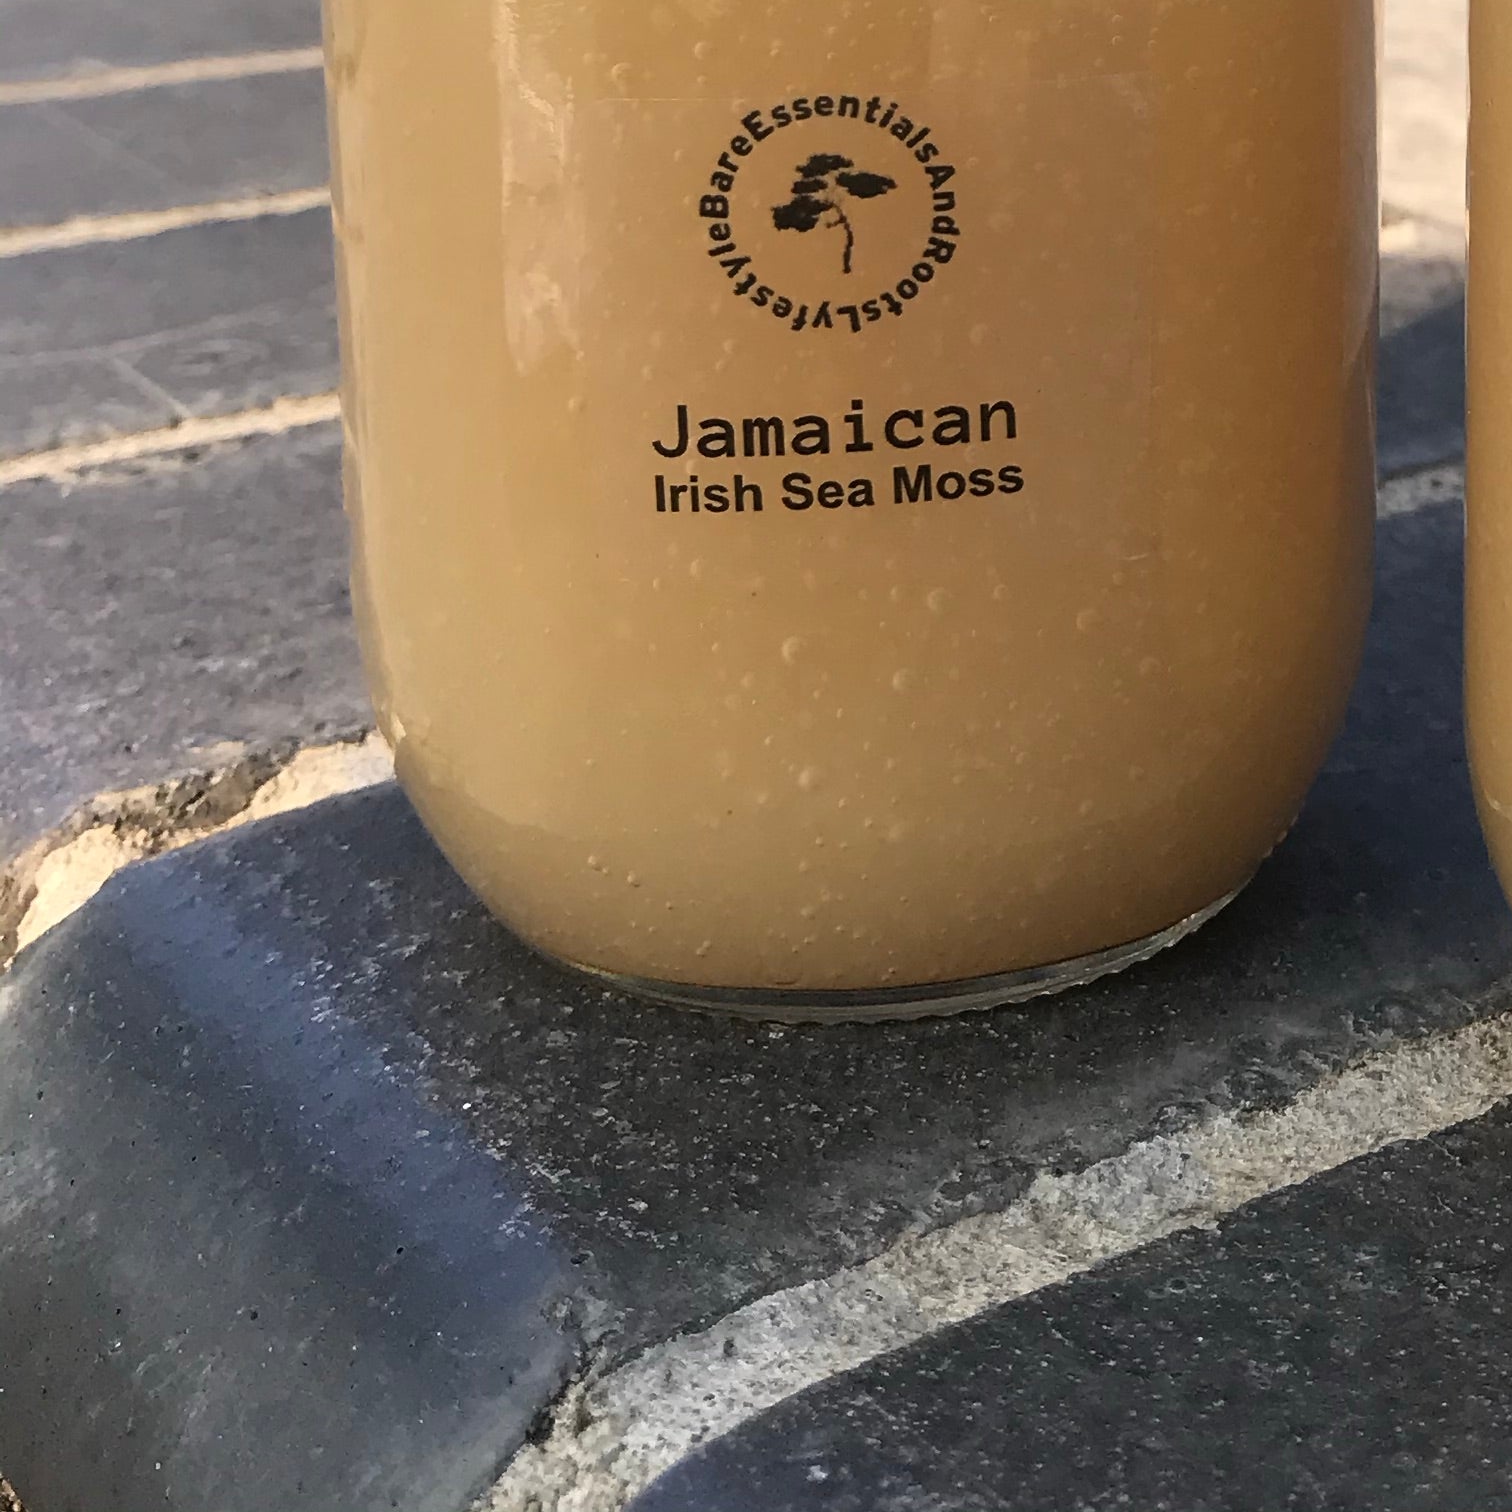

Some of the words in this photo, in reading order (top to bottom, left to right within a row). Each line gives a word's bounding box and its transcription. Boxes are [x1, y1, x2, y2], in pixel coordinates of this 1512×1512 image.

[652, 399, 1017, 458] Jamaican
[654, 474, 764, 513] Irish
[781, 471, 876, 511] Sea
[892, 463, 1025, 505] Moss
